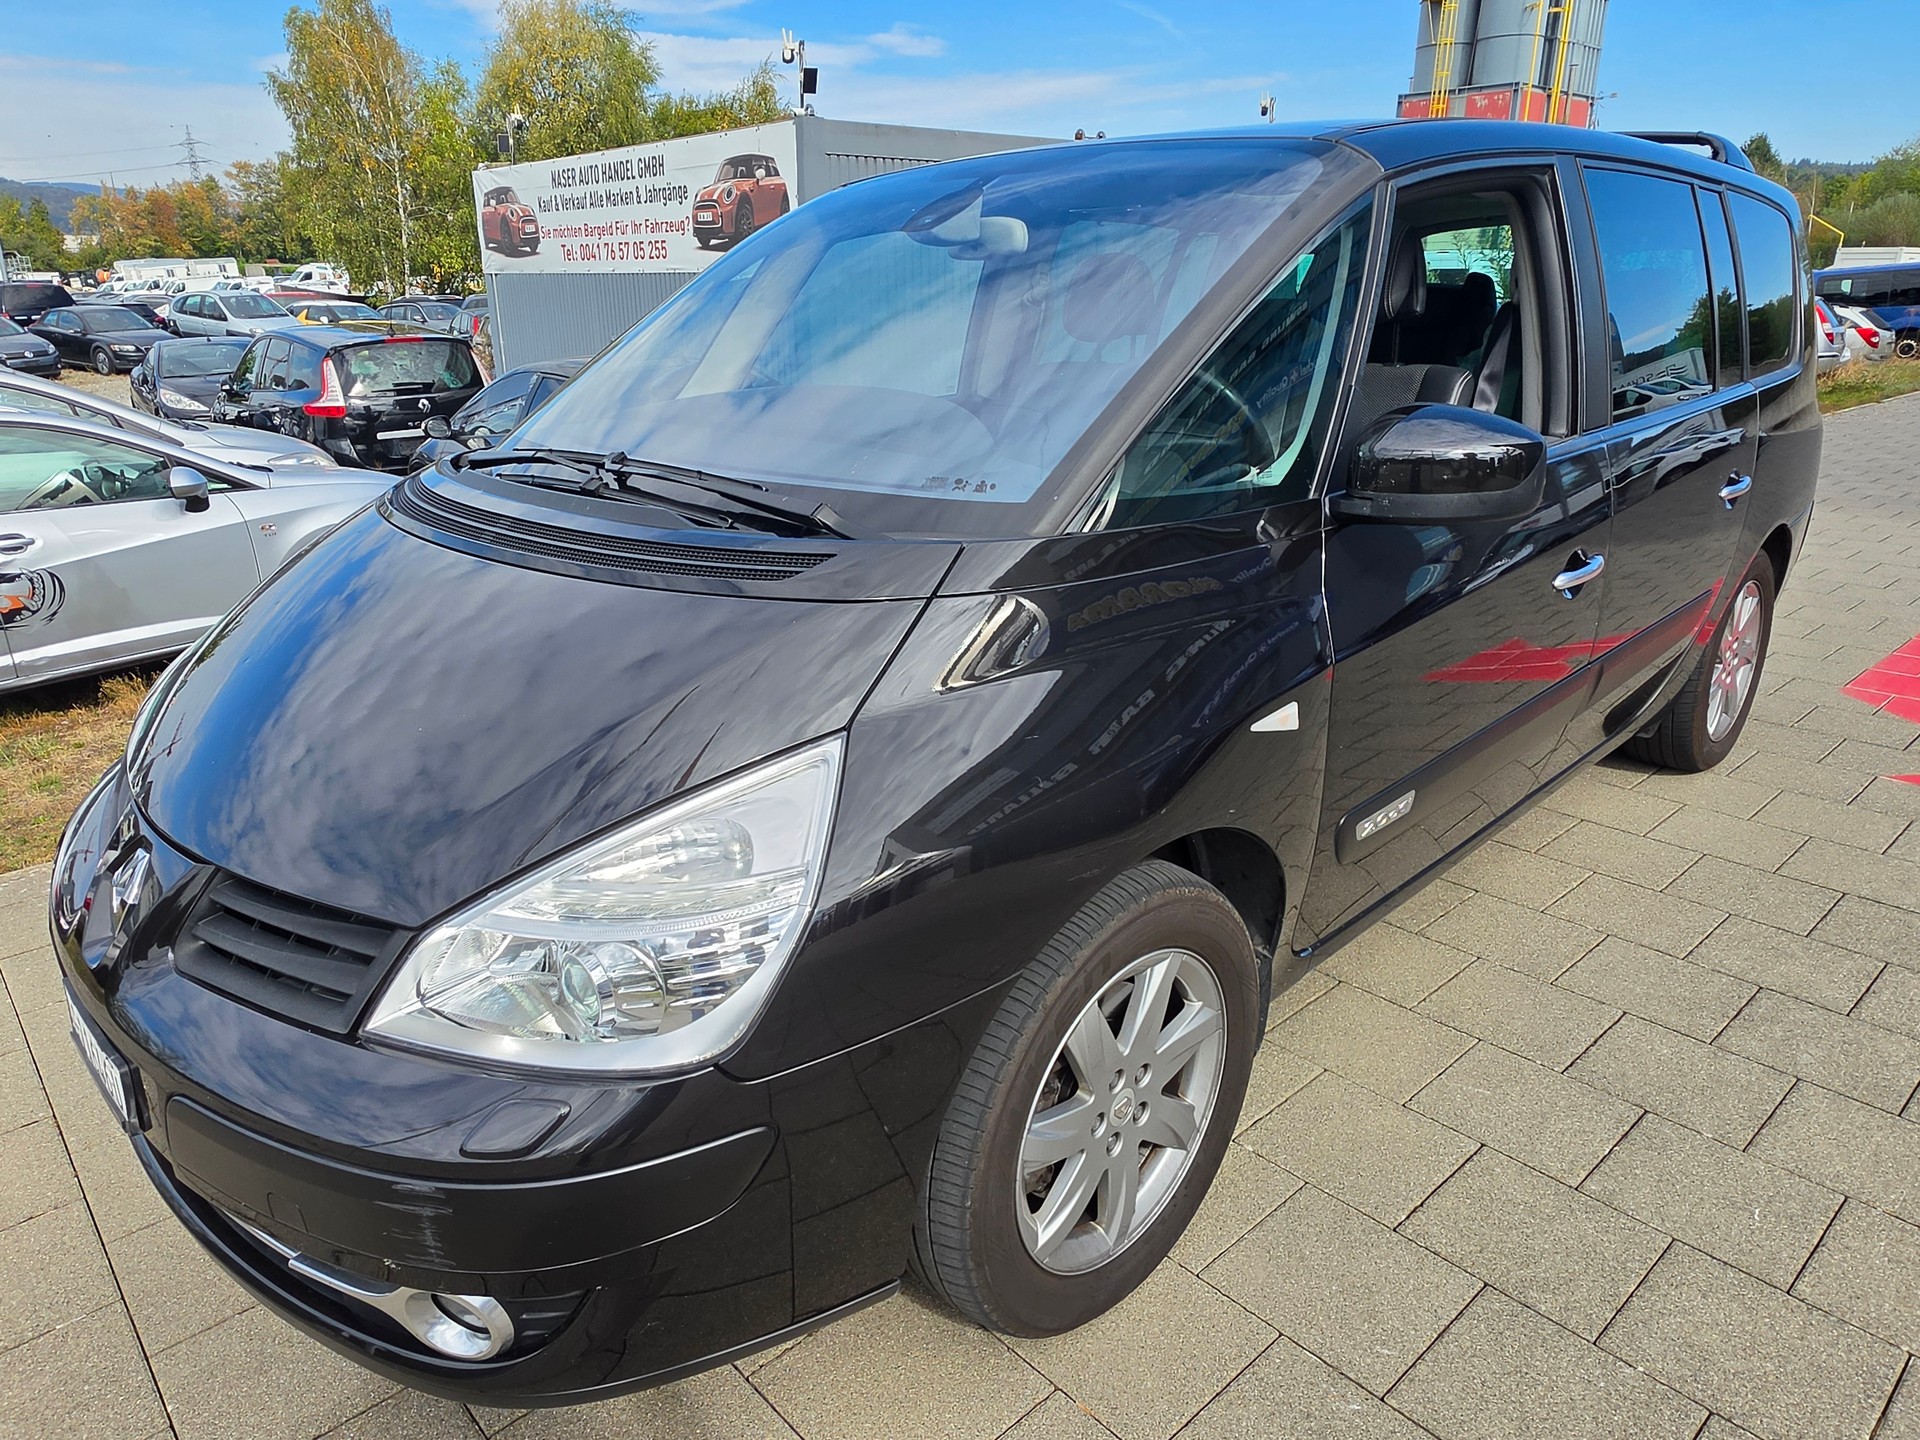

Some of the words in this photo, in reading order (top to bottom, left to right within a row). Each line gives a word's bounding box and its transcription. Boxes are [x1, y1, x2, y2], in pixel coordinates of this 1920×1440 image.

[551, 167, 577, 189] NASER
[579, 164, 600, 186] AUTO
[601, 159, 636, 184] HANDEL
[637, 154, 665, 179] GMBH
[537, 193, 553, 213] Kauf
[554, 194, 560, 212] &
[560, 191, 588, 211] Verkauf
[589, 190, 604, 209] Alle
[605, 187, 635, 208] Marken
[635, 185, 643, 205] &
[643, 181, 689, 207] Jahrgänge
[540, 225, 552, 239] Sie
[552, 223, 583, 239] möchten
[583, 220, 614, 240] Bargeld
[615, 218, 629, 236] Für
[630, 218, 643, 235] Ihr
[644, 215, 691, 236] Fahrzeug?
[560, 243, 578, 262] Tel:
[579, 242, 602, 262] 0041
[603, 241, 616, 261] 76
[618, 240, 630, 261] 57
[632, 239, 646, 260] 05
[647, 239, 668, 260] 255
